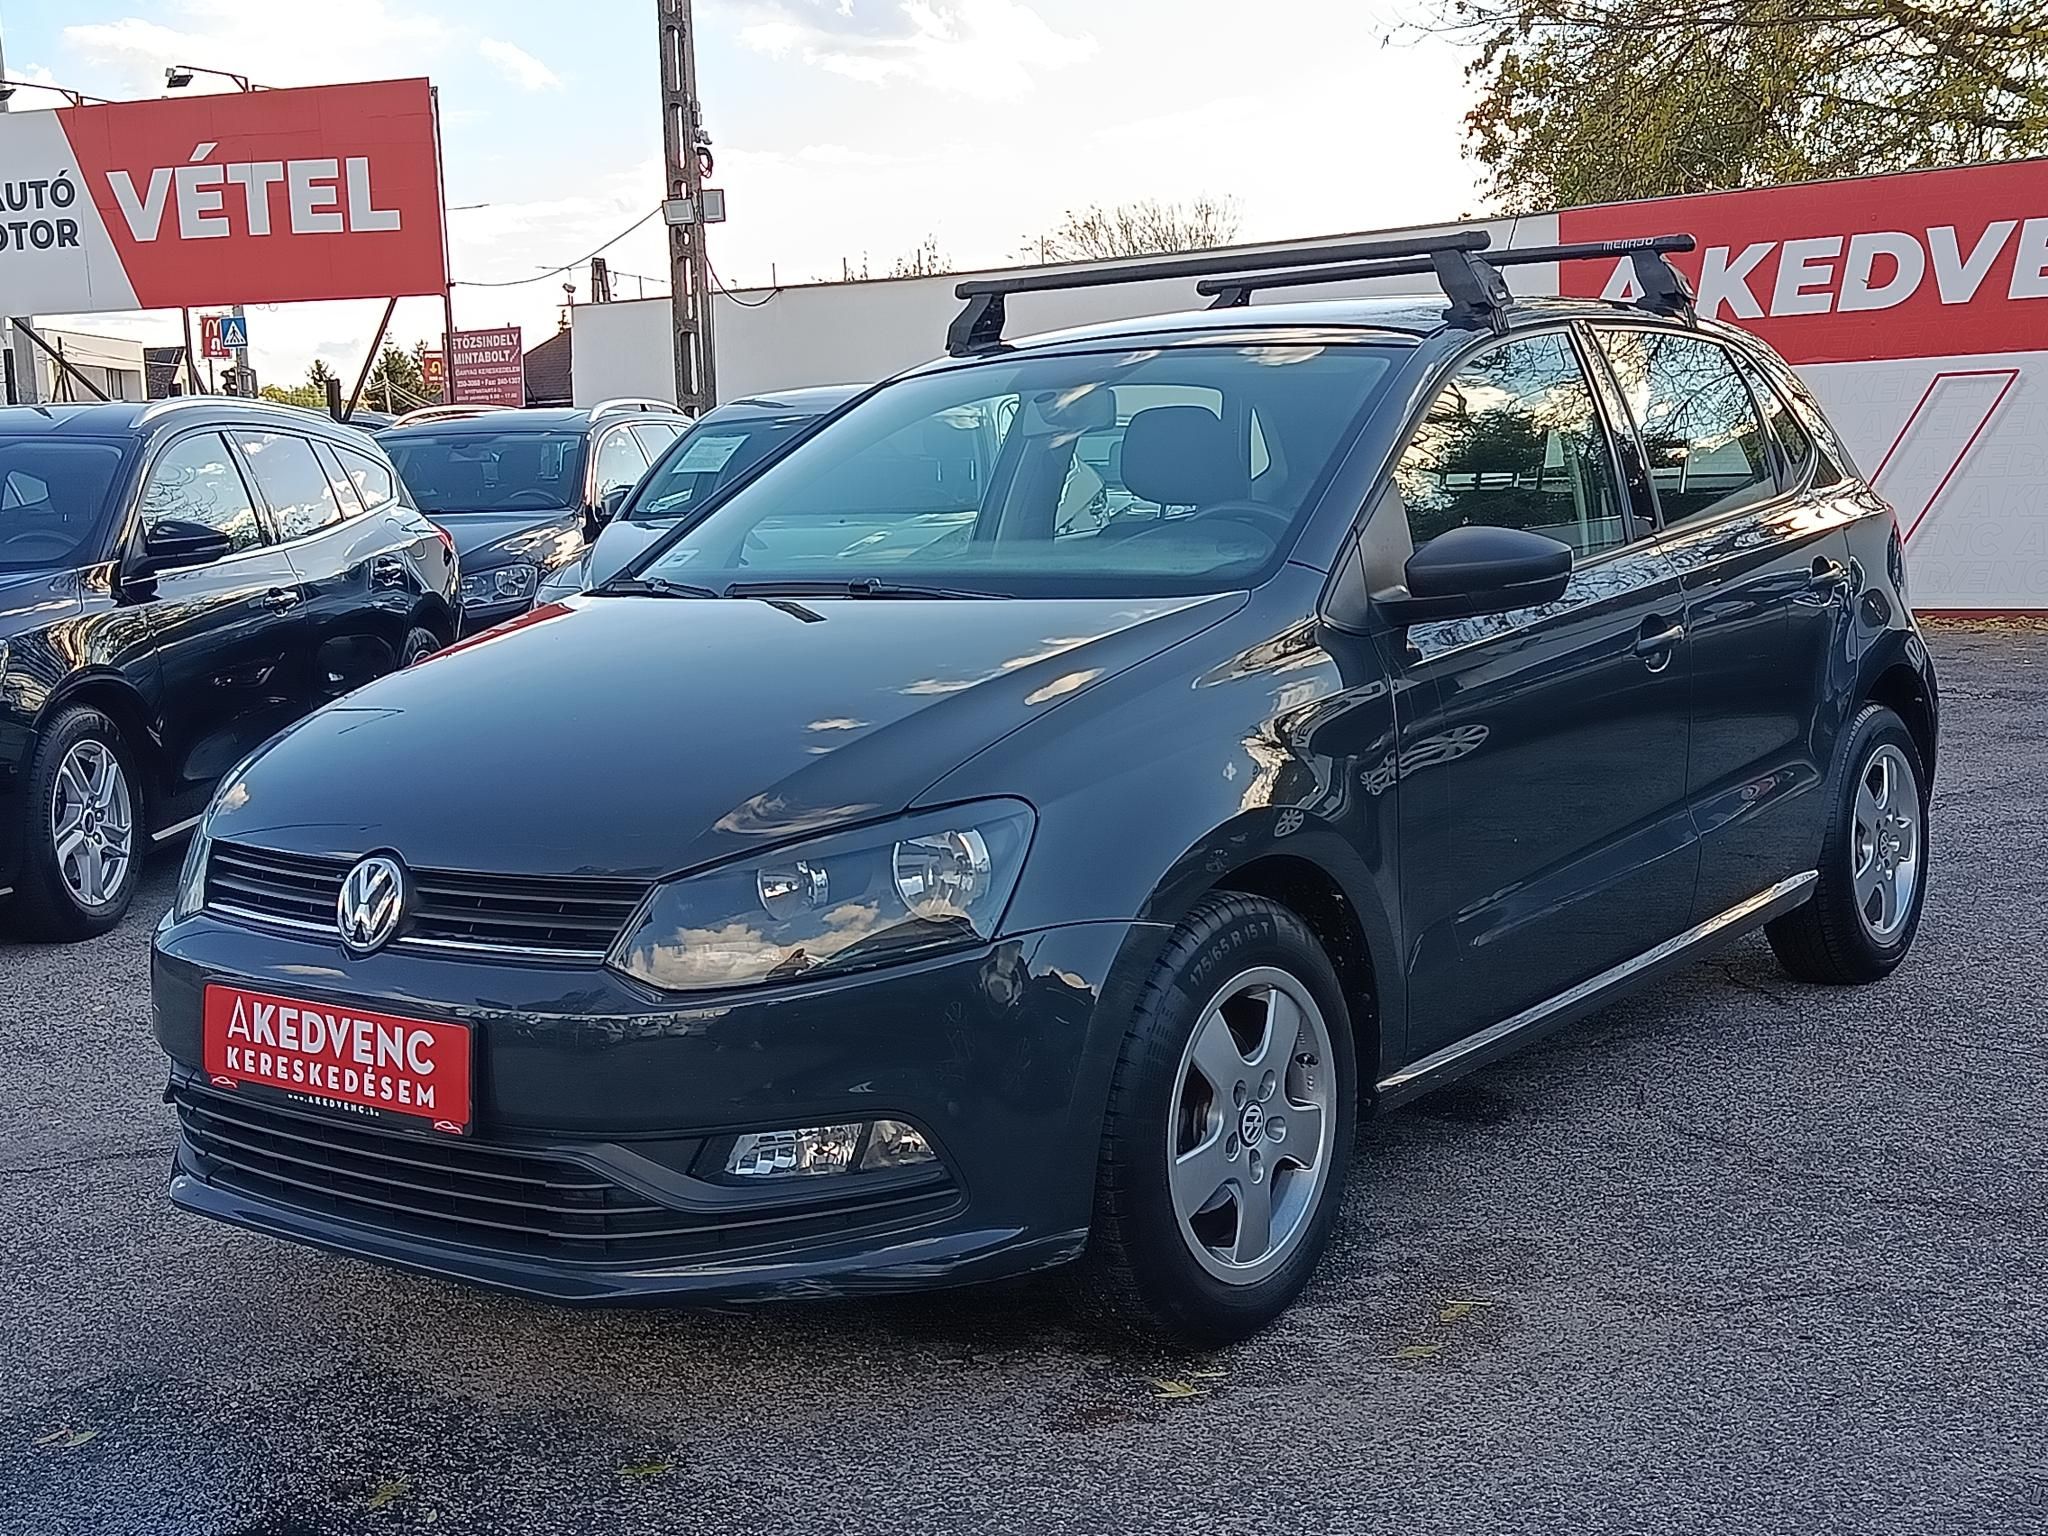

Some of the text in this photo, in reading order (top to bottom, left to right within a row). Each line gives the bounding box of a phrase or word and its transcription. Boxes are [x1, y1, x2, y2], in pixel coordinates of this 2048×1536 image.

[0, 168, 76, 212] UTÓ
[105, 142, 402, 242] VÉTEL
[1189, 921, 1270, 987] 175/65 R 15 T
[226, 1046, 436, 1109] KERESKEDÉSEM
